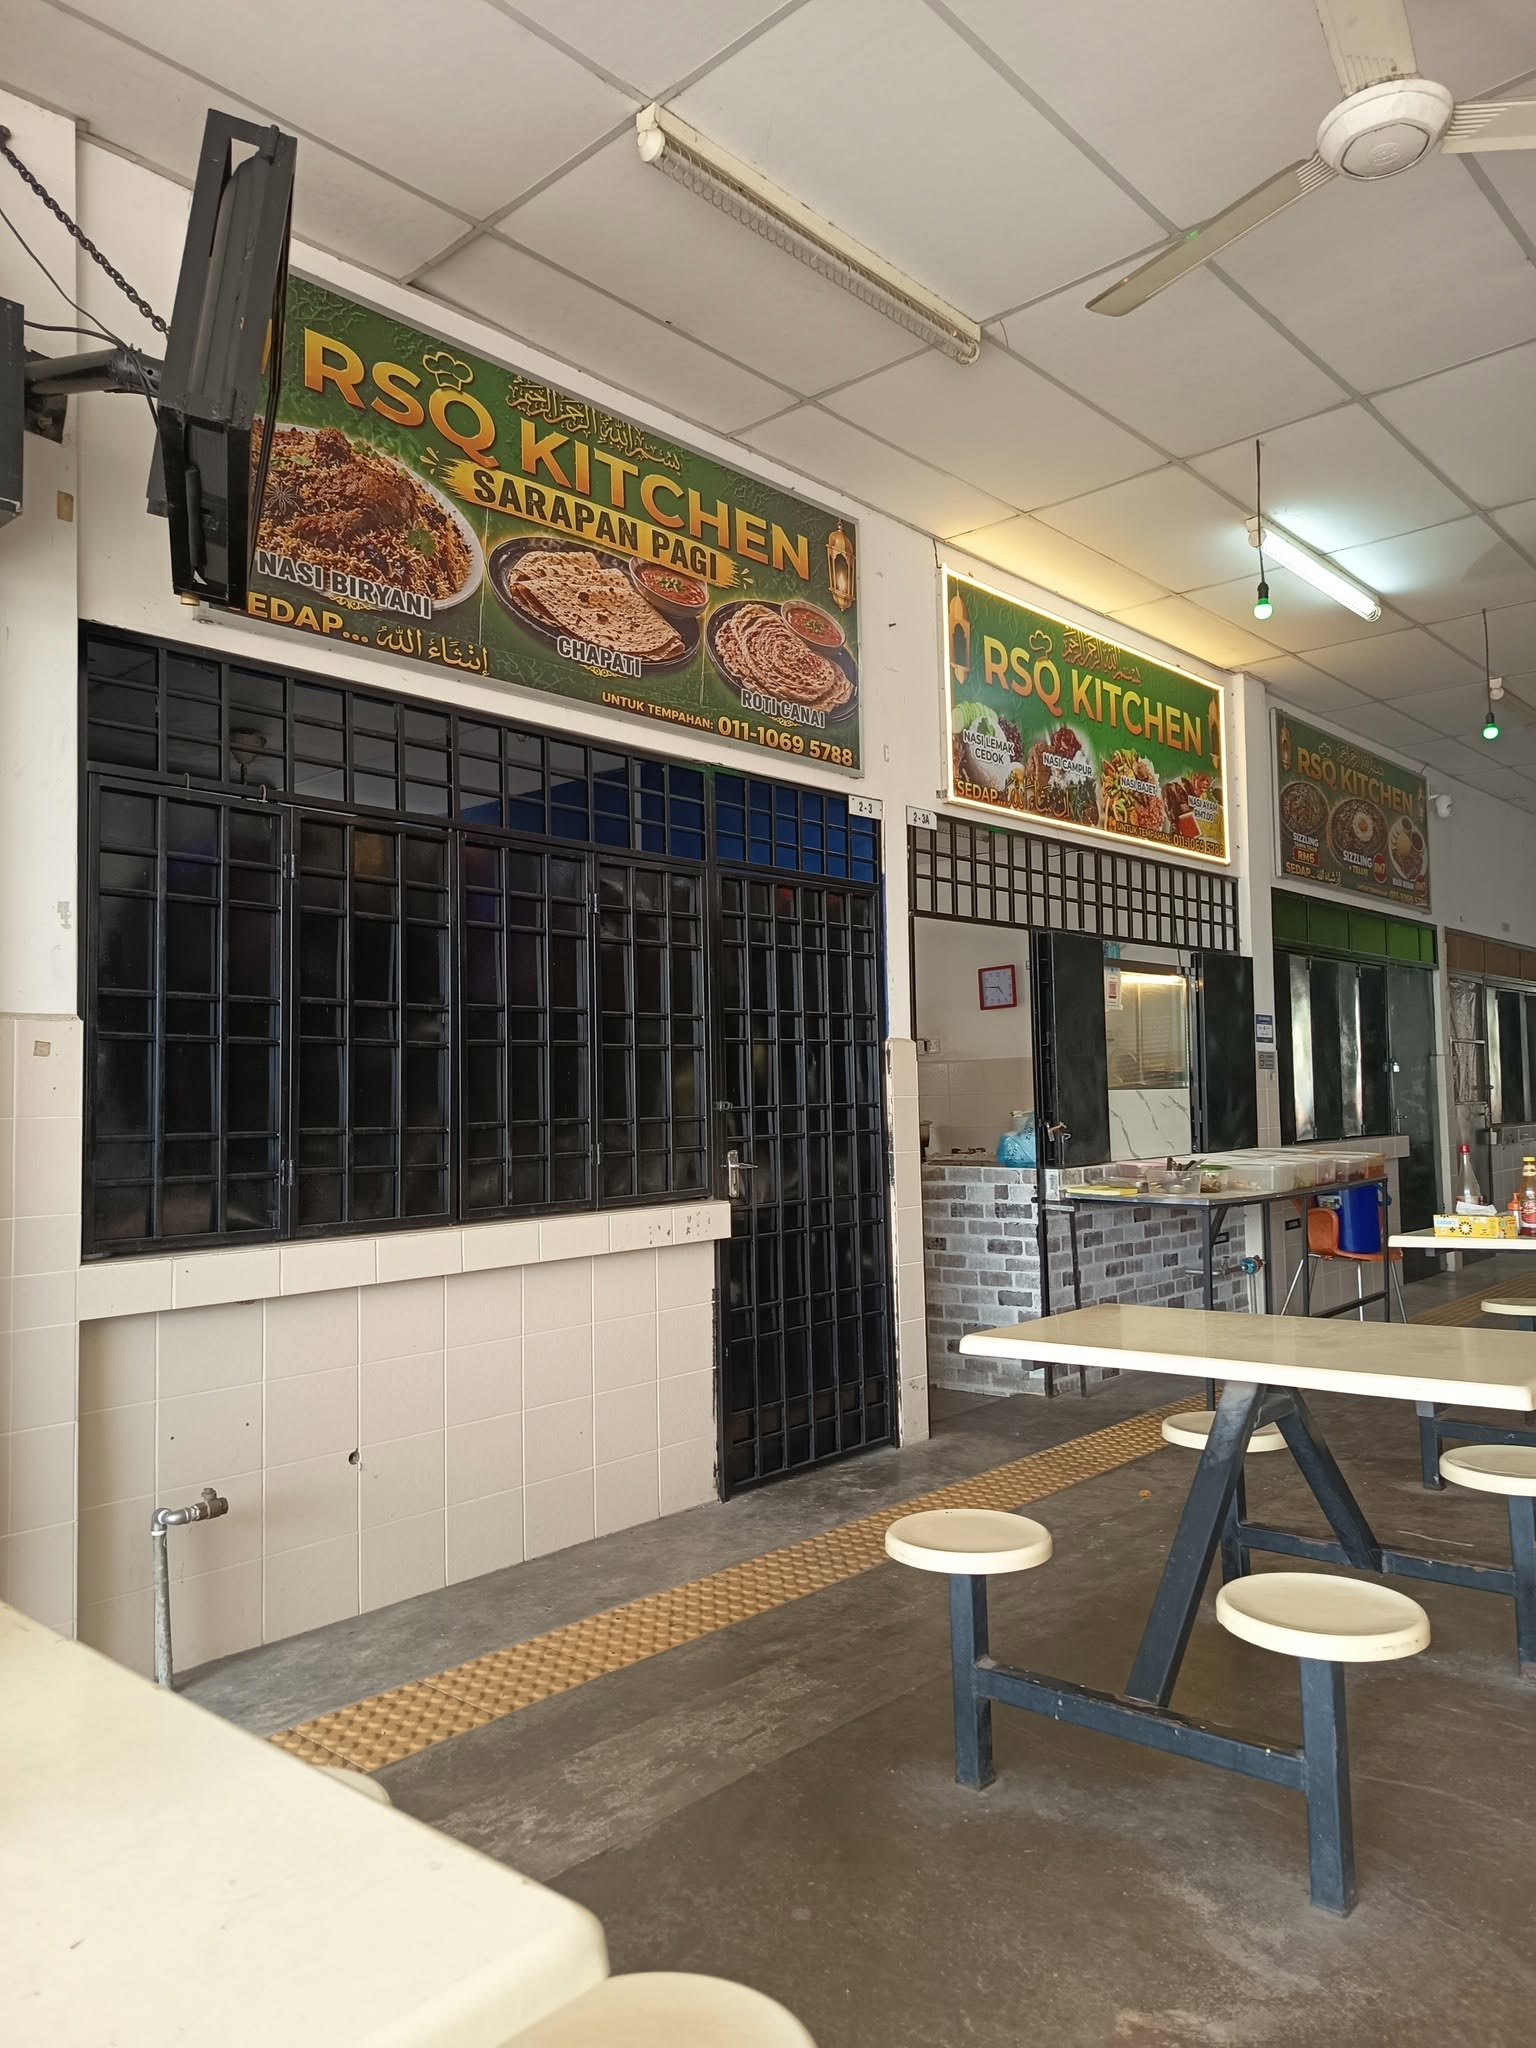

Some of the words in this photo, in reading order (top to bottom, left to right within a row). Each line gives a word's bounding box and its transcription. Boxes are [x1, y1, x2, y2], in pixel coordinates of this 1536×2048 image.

[304, 327, 499, 469] RSQ
[520, 418, 809, 582] KITCHEN
[473, 470, 639, 551] SARAPAN
[652, 532, 718, 581] PAGI
[257, 550, 323, 589] NASI
[331, 570, 433, 620] BIRYANI
[229, 591, 369, 644] EDAP...
[556, 635, 643, 679] CHAPATI
[602, 692, 645, 713] UNTUK
[647, 703, 714, 730] TEMPAHAN:
[741, 688, 779, 717] ROTI
[779, 702, 826, 729] CANAI
[983, 635, 1063, 717] RSQ
[1072, 669, 1202, 756] KITCHEN
[717, 716, 804, 754] 011-1069
[809, 740, 853, 767] 5788
[963, 729, 985, 746] NASI
[986, 735, 1015, 756] LEMAK
[974, 748, 1005, 765] CEDOK
[1043, 752, 1061, 768] NASI
[1062, 760, 1093, 777] CAMPUR
[1298, 747, 1338, 792] RSQ
[1341, 764, 1413, 816] KITCHEN
[1121, 777, 1136, 791] NASI
[1137, 781, 1158, 796] BAJET
[1117, 821, 1138, 836] UNTUK
[1293, 832, 1319, 847] SIZZLING
[1343, 850, 1373, 868] SIZZLING
